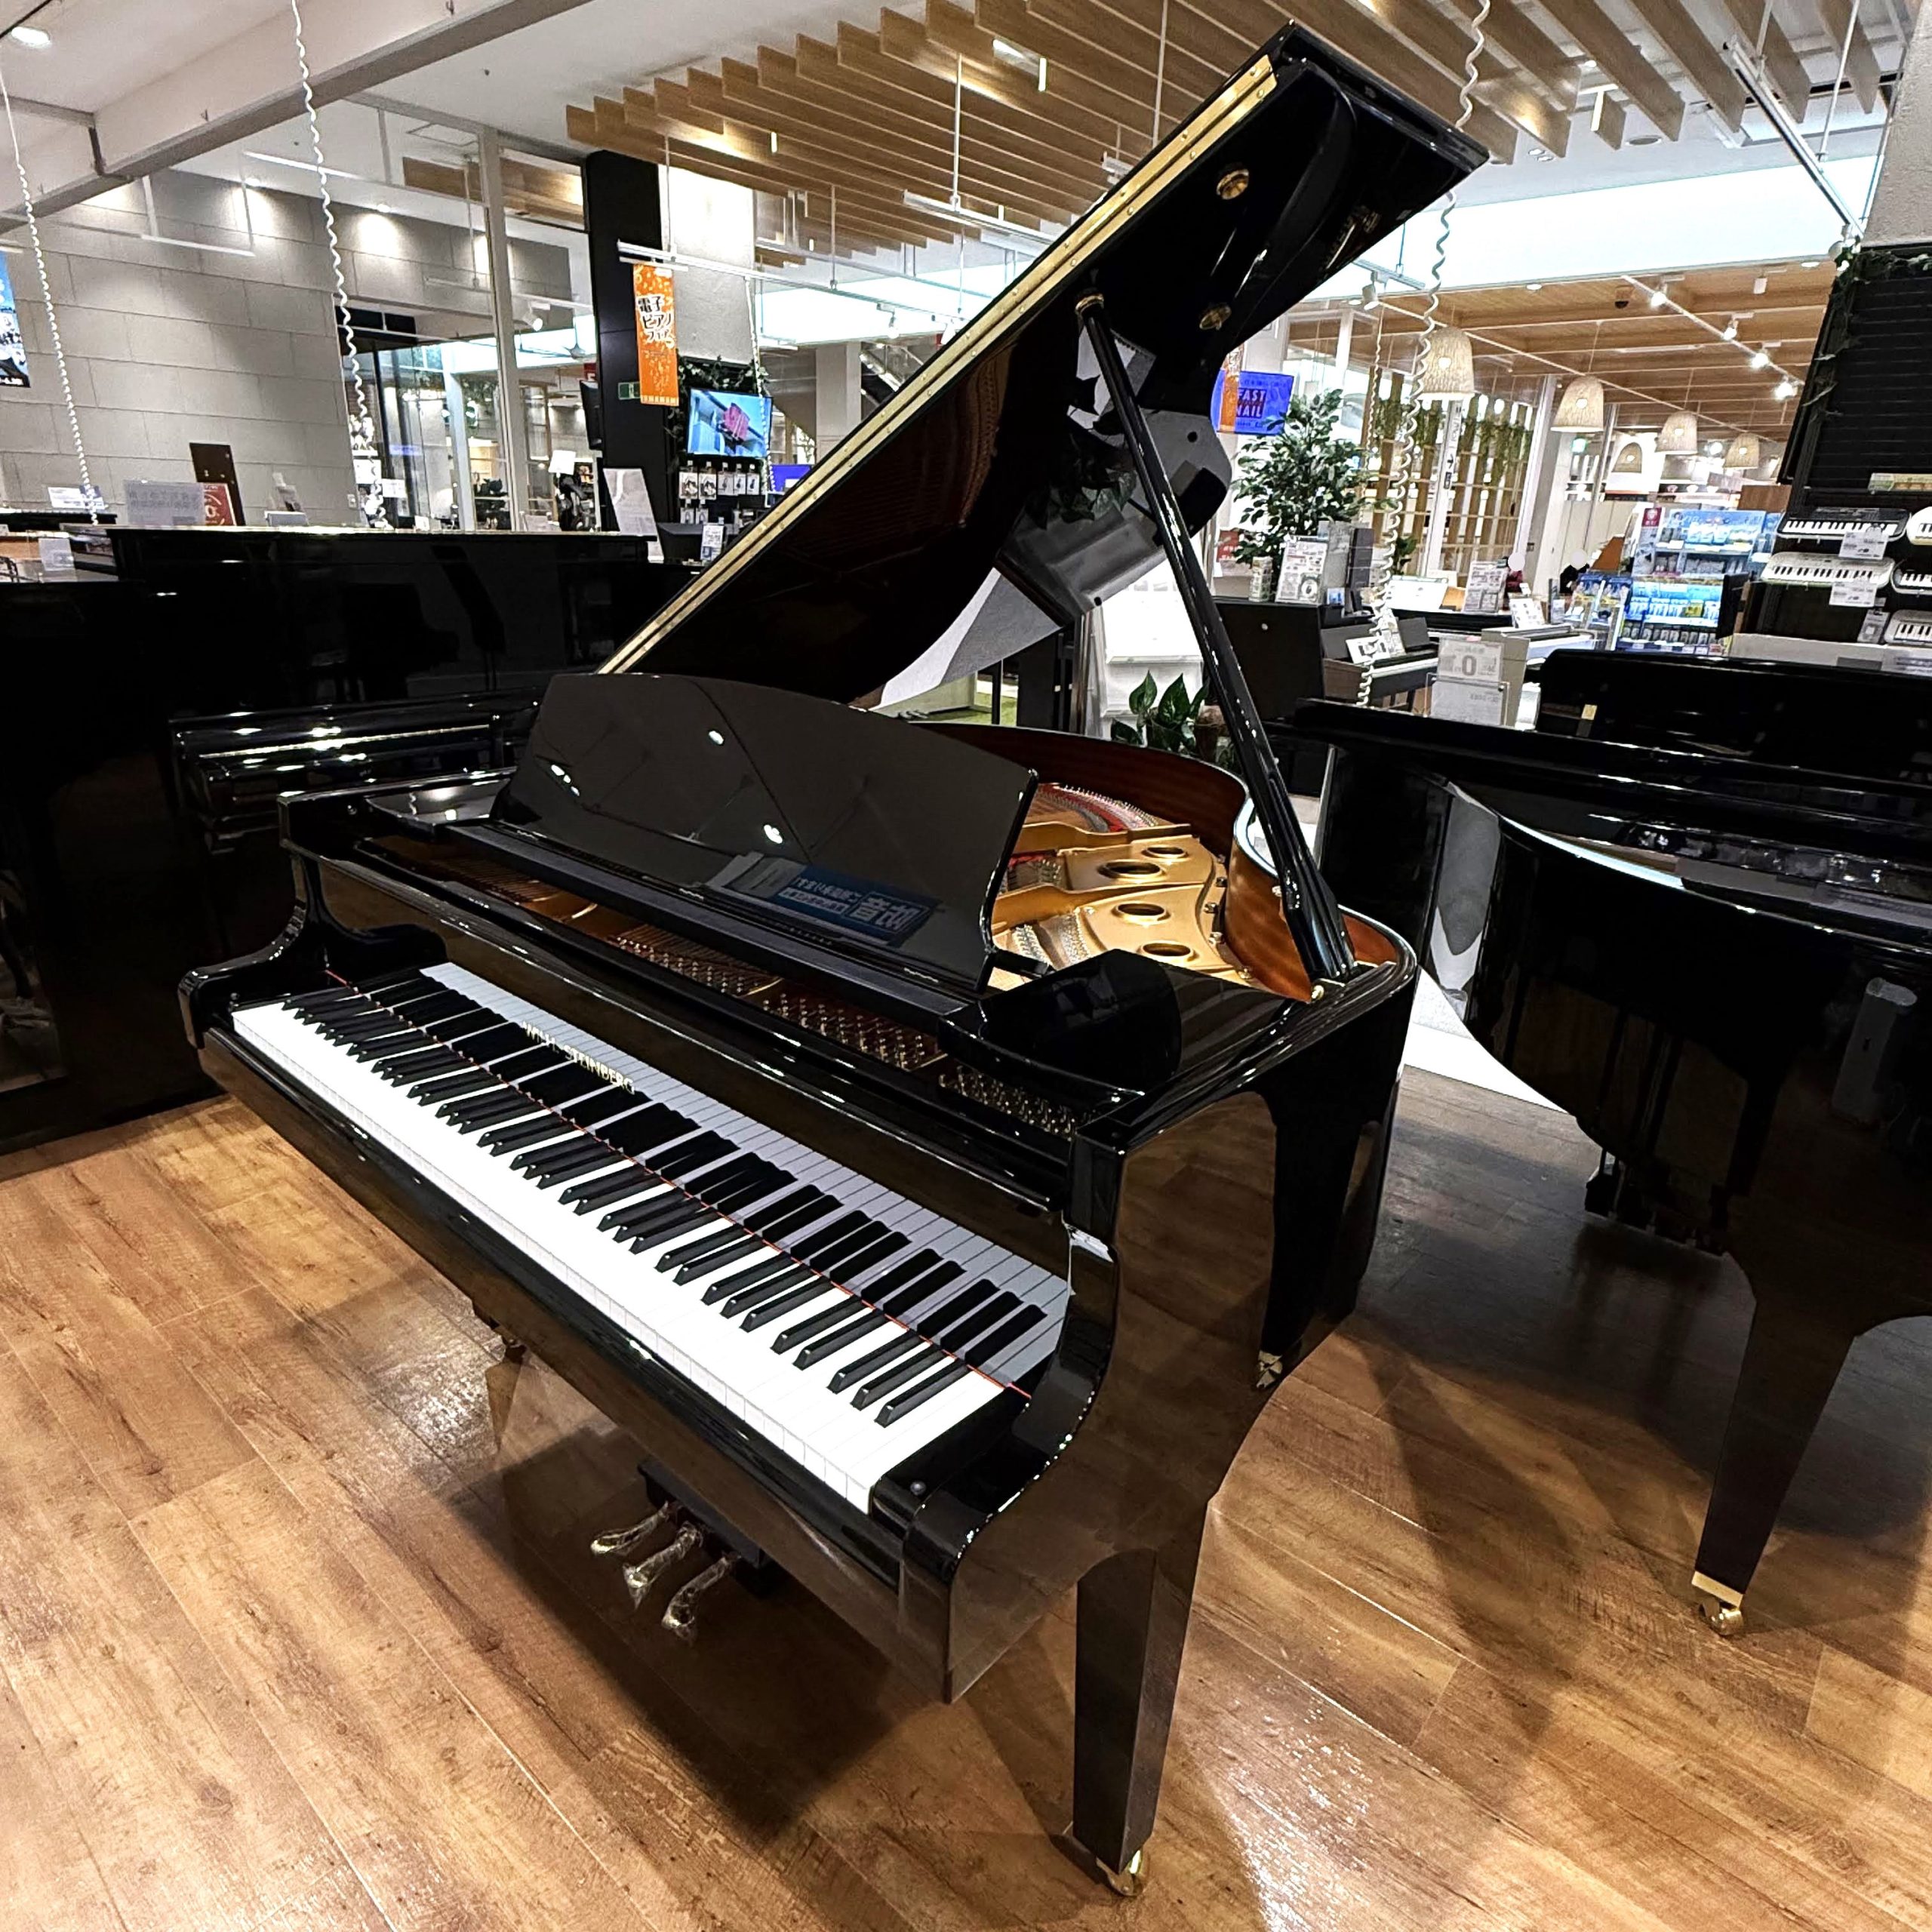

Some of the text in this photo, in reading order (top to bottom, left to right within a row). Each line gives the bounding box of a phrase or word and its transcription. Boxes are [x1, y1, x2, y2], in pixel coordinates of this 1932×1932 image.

[638, 295, 662, 312] 電子
[642, 313, 671, 329] ピアノ
[1238, 389, 1266, 401] FAST
[564, 1044, 635, 1095] STEINBERG
